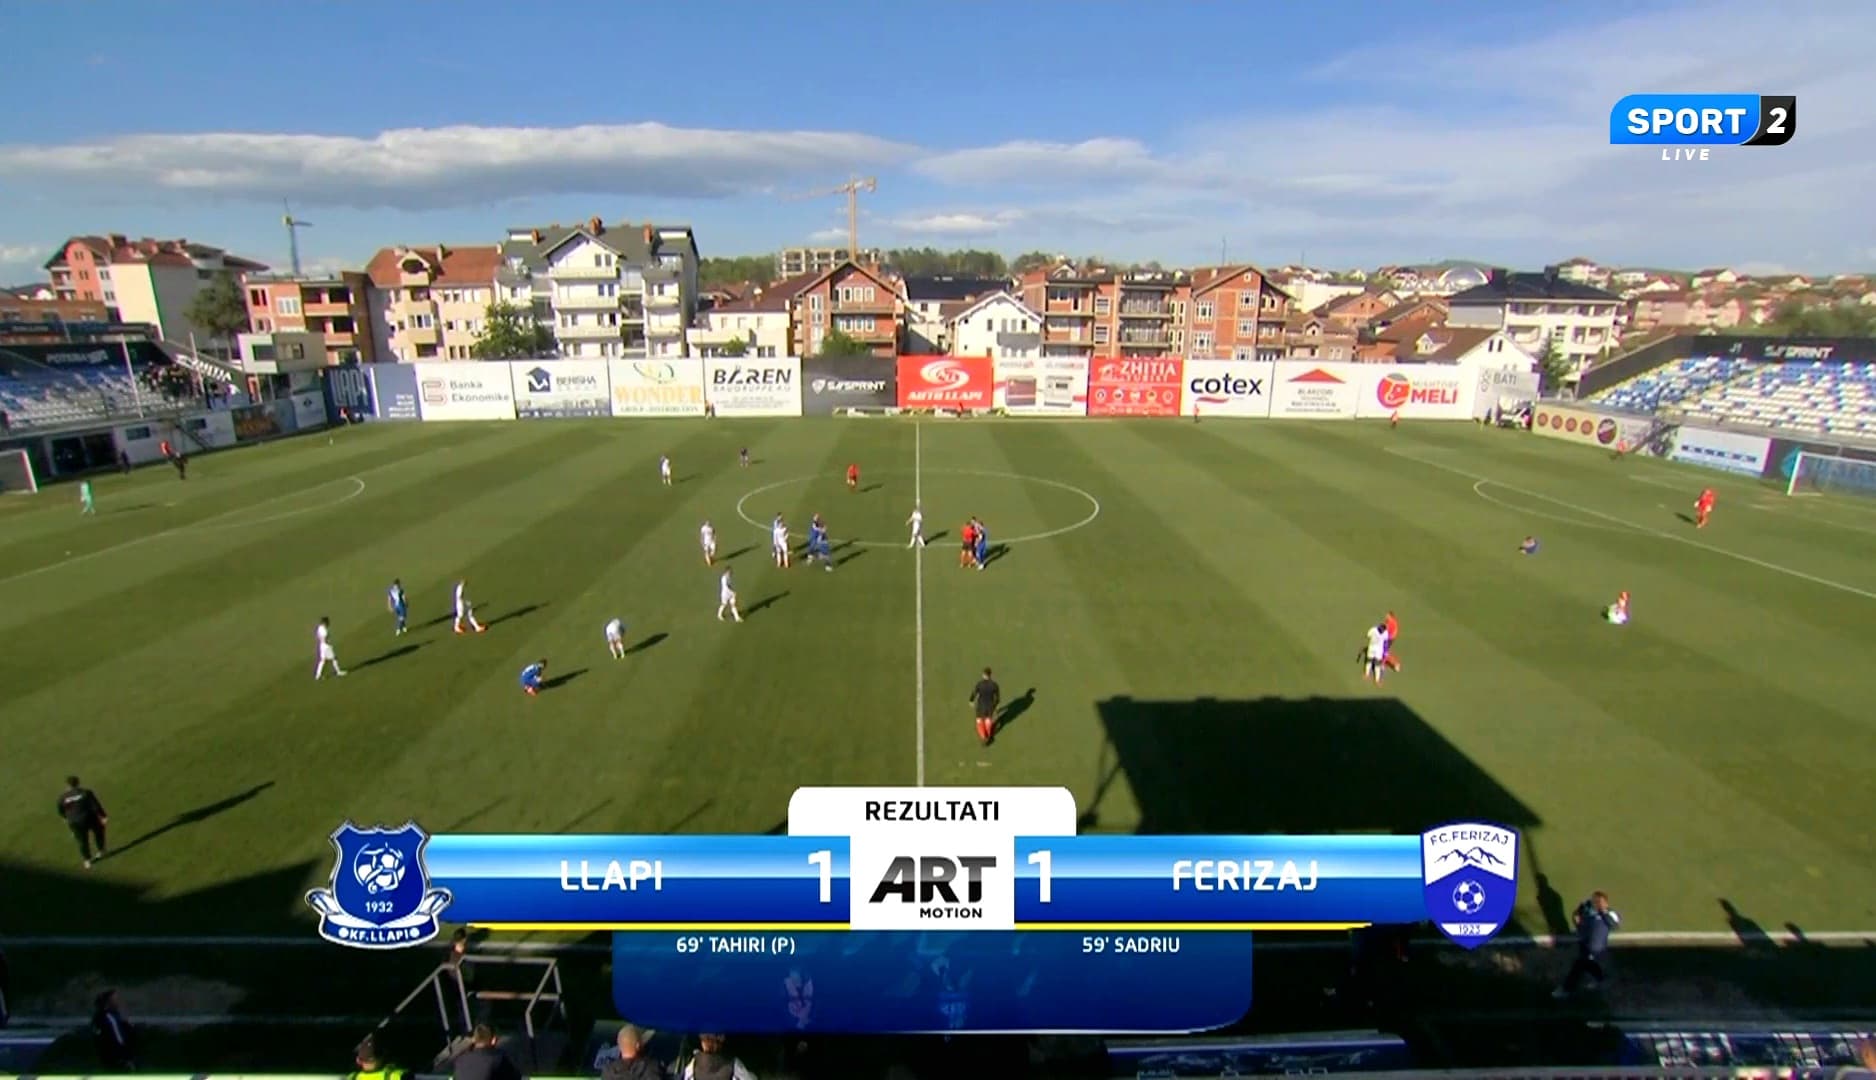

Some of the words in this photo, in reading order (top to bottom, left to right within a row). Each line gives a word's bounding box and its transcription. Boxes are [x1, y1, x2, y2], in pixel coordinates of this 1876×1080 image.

[1121, 361, 1176, 376] ZHITIA
[450, 380, 483, 389] Banka
[1191, 373, 1263, 395] cotex
[452, 394, 510, 403] Ekonomike
[615, 384, 702, 403] WONDER
[1411, 388, 1458, 404] MELI
